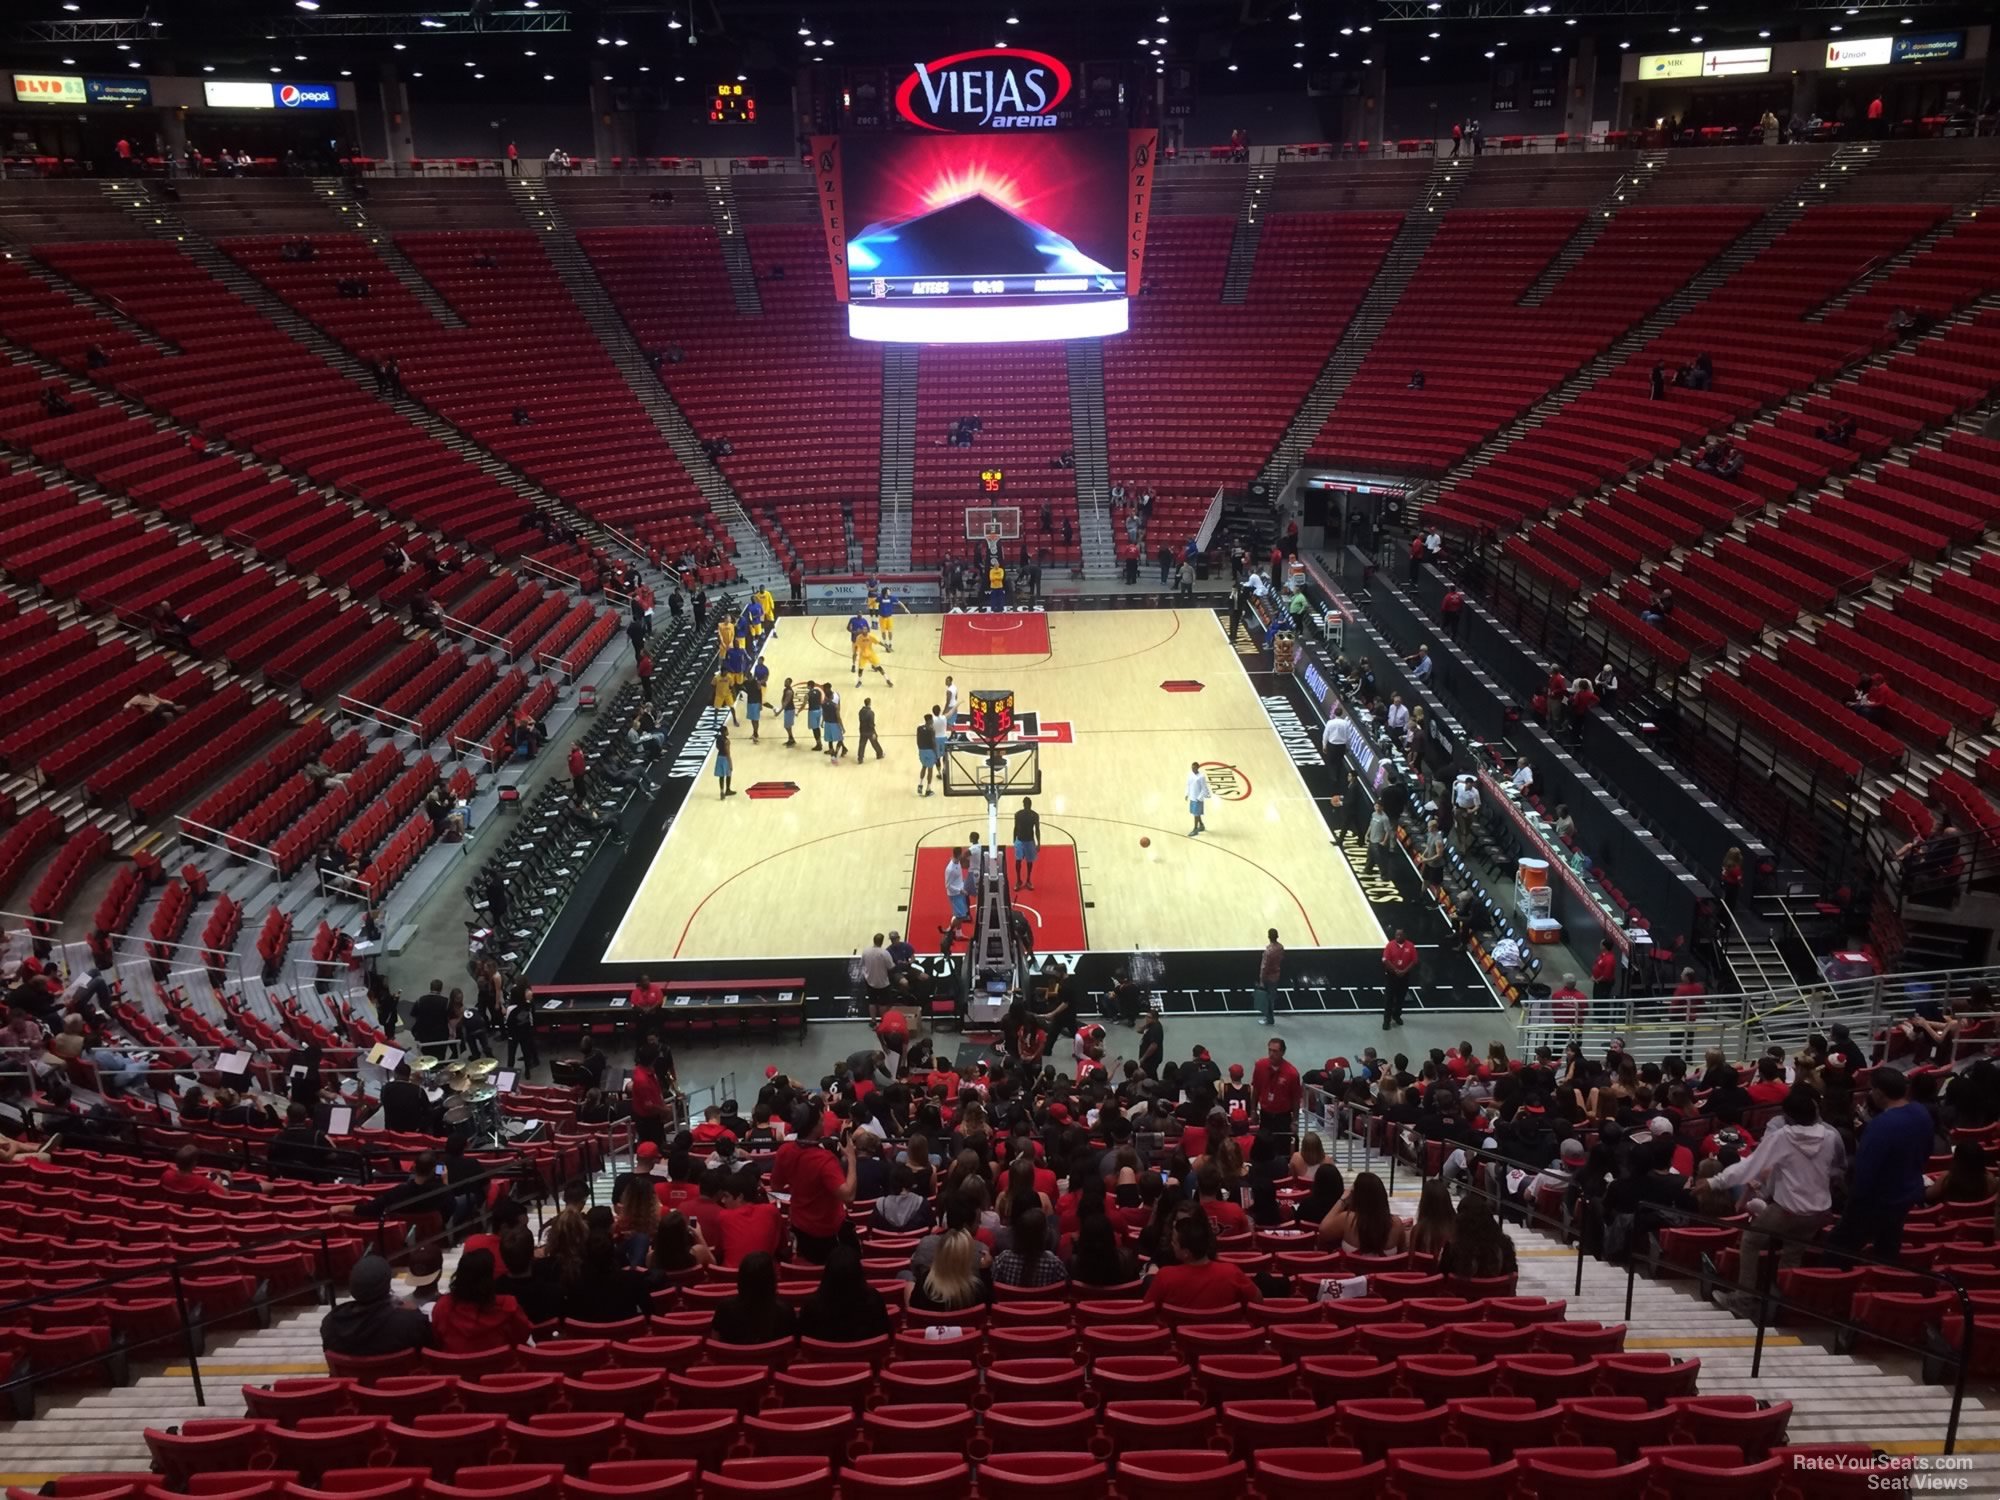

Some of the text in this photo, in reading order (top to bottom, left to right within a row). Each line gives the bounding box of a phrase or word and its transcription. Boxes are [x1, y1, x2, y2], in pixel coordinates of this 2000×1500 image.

[15, 79, 63, 93] BLVD
[301, 92, 330, 102] pepsi
[914, 63, 1047, 126] VIEJAS
[716, 100, 722, 110] 0
[748, 100, 754, 109] 0
[1169, 106, 1190, 114] 2012
[992, 113, 1057, 128] arena
[820, 151, 843, 265] AZTECS
[1132, 144, 1149, 260] AZTECS
[986, 480, 998, 491] 35
[835, 585, 854, 593] MRC
[1260, 696, 1325, 766] SAN DIEGO STATE
[668, 706, 730, 777] SAN DIEGO STATE
[1205, 765, 1240, 801] VIEJAS
[829, 1081, 838, 1094] 6
[1229, 1100, 1246, 1115] 21
